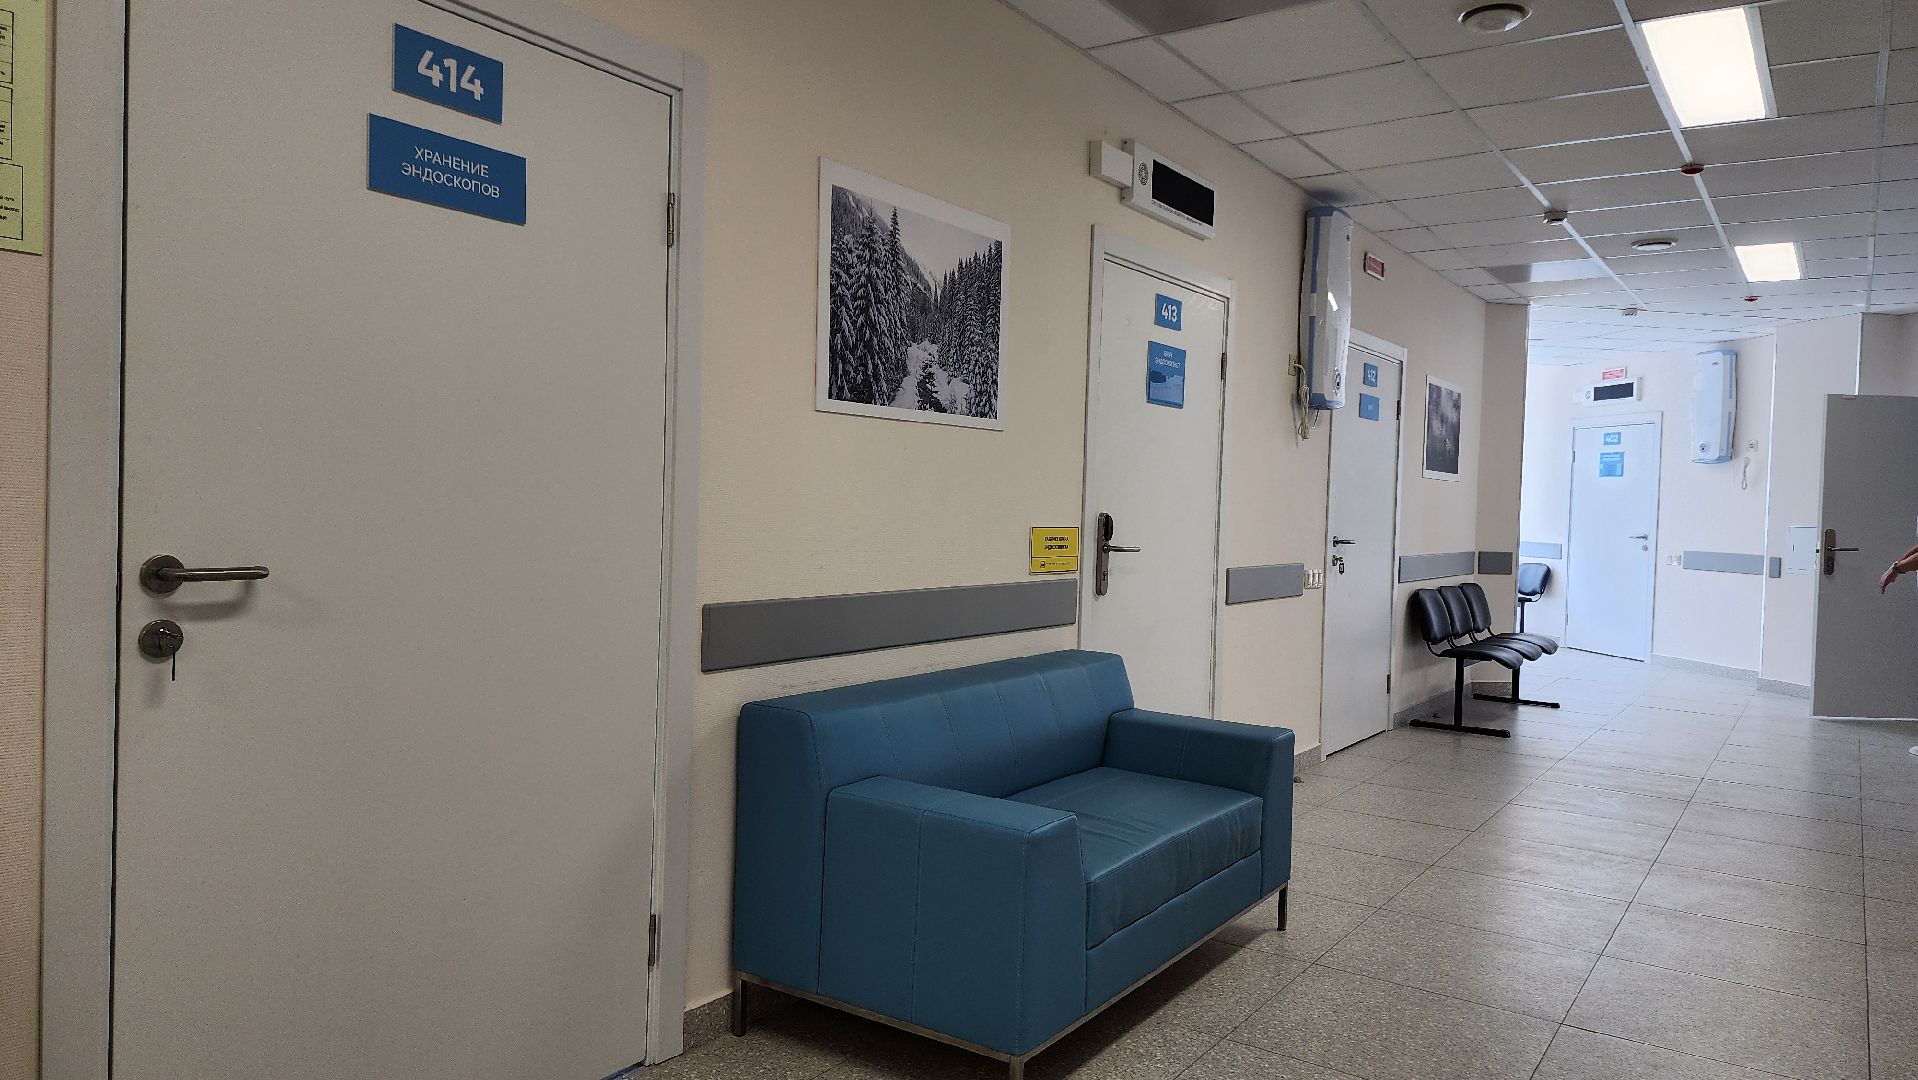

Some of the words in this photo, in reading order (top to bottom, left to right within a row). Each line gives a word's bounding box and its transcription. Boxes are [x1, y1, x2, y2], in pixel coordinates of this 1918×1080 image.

[417, 49, 485, 102] 414
[414, 145, 489, 178] ХРАНЕНИЕ
[401, 162, 500, 198] ЭНДОСКОПОВ
[1161, 303, 1178, 323] 413
